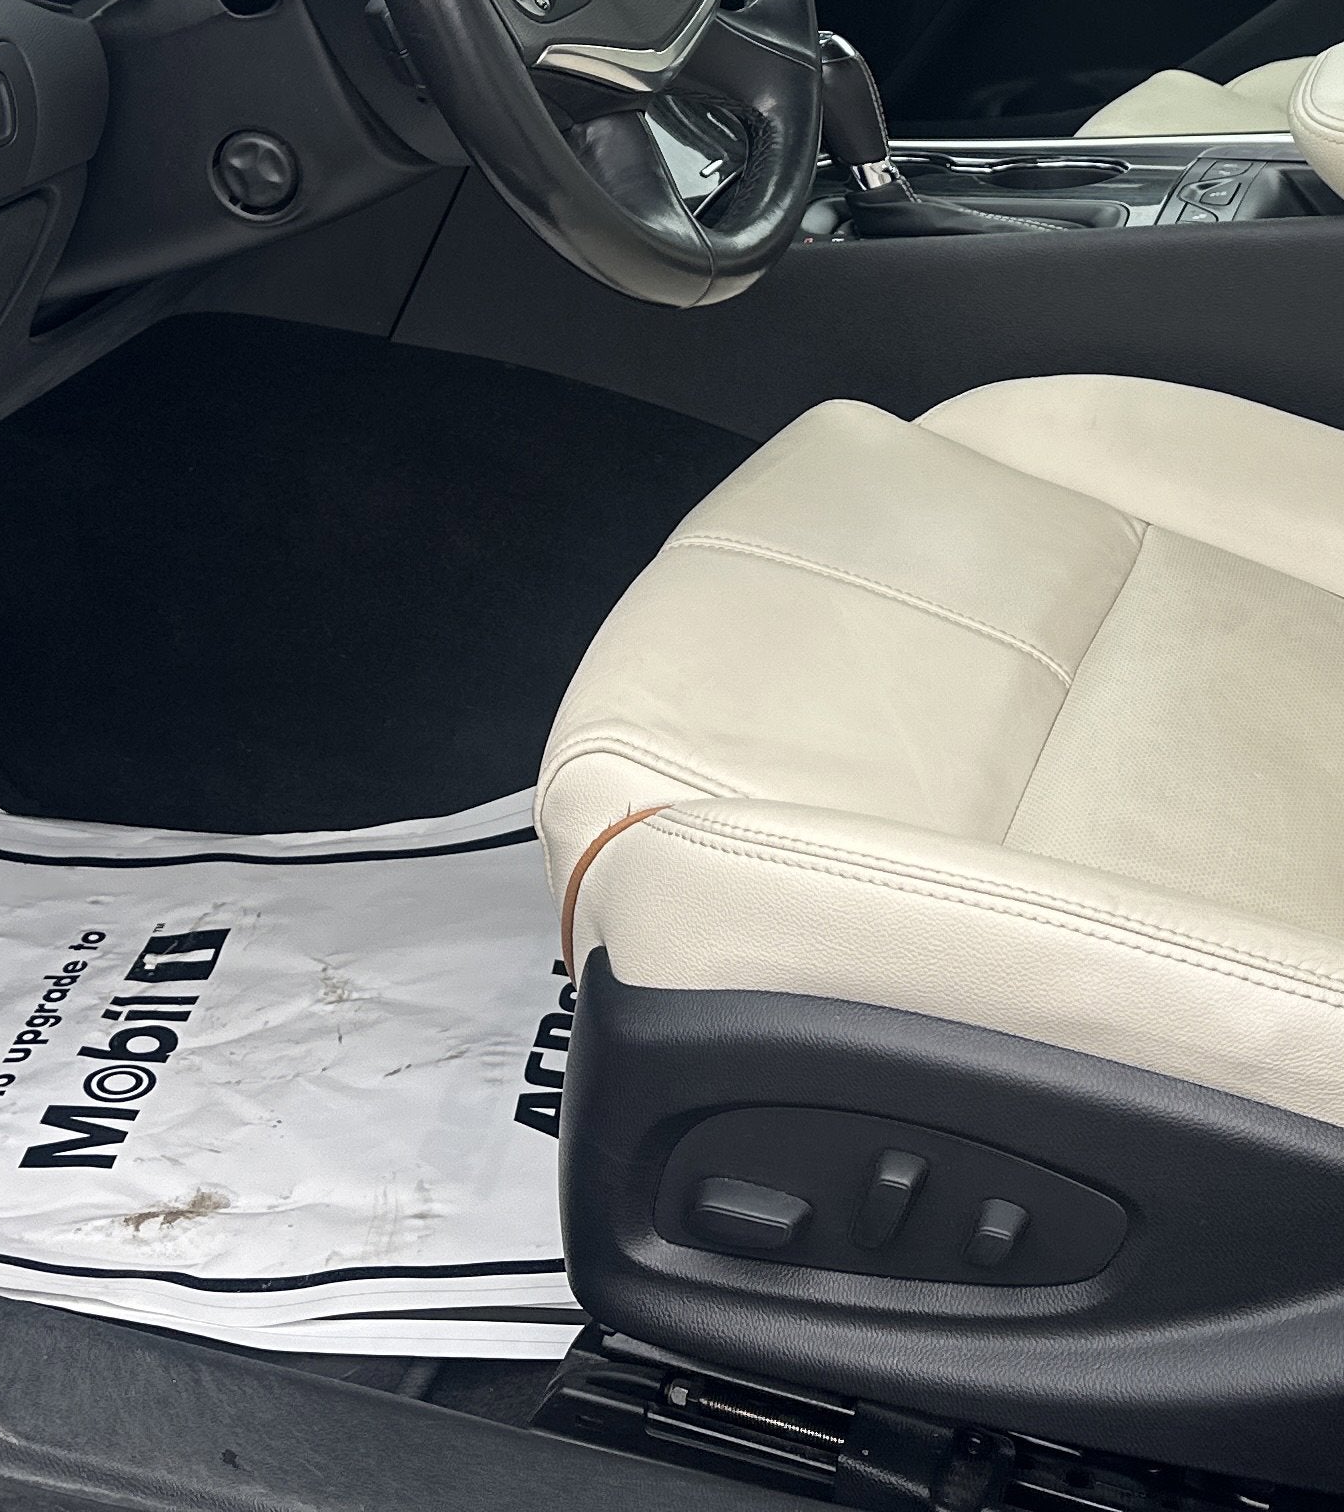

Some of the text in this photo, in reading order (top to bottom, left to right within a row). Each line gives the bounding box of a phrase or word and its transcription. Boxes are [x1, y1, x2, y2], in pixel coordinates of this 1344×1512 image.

[2, 960, 88, 1063] upgrade
[69, 931, 106, 951] to
[18, 995, 200, 1169] Mobil
